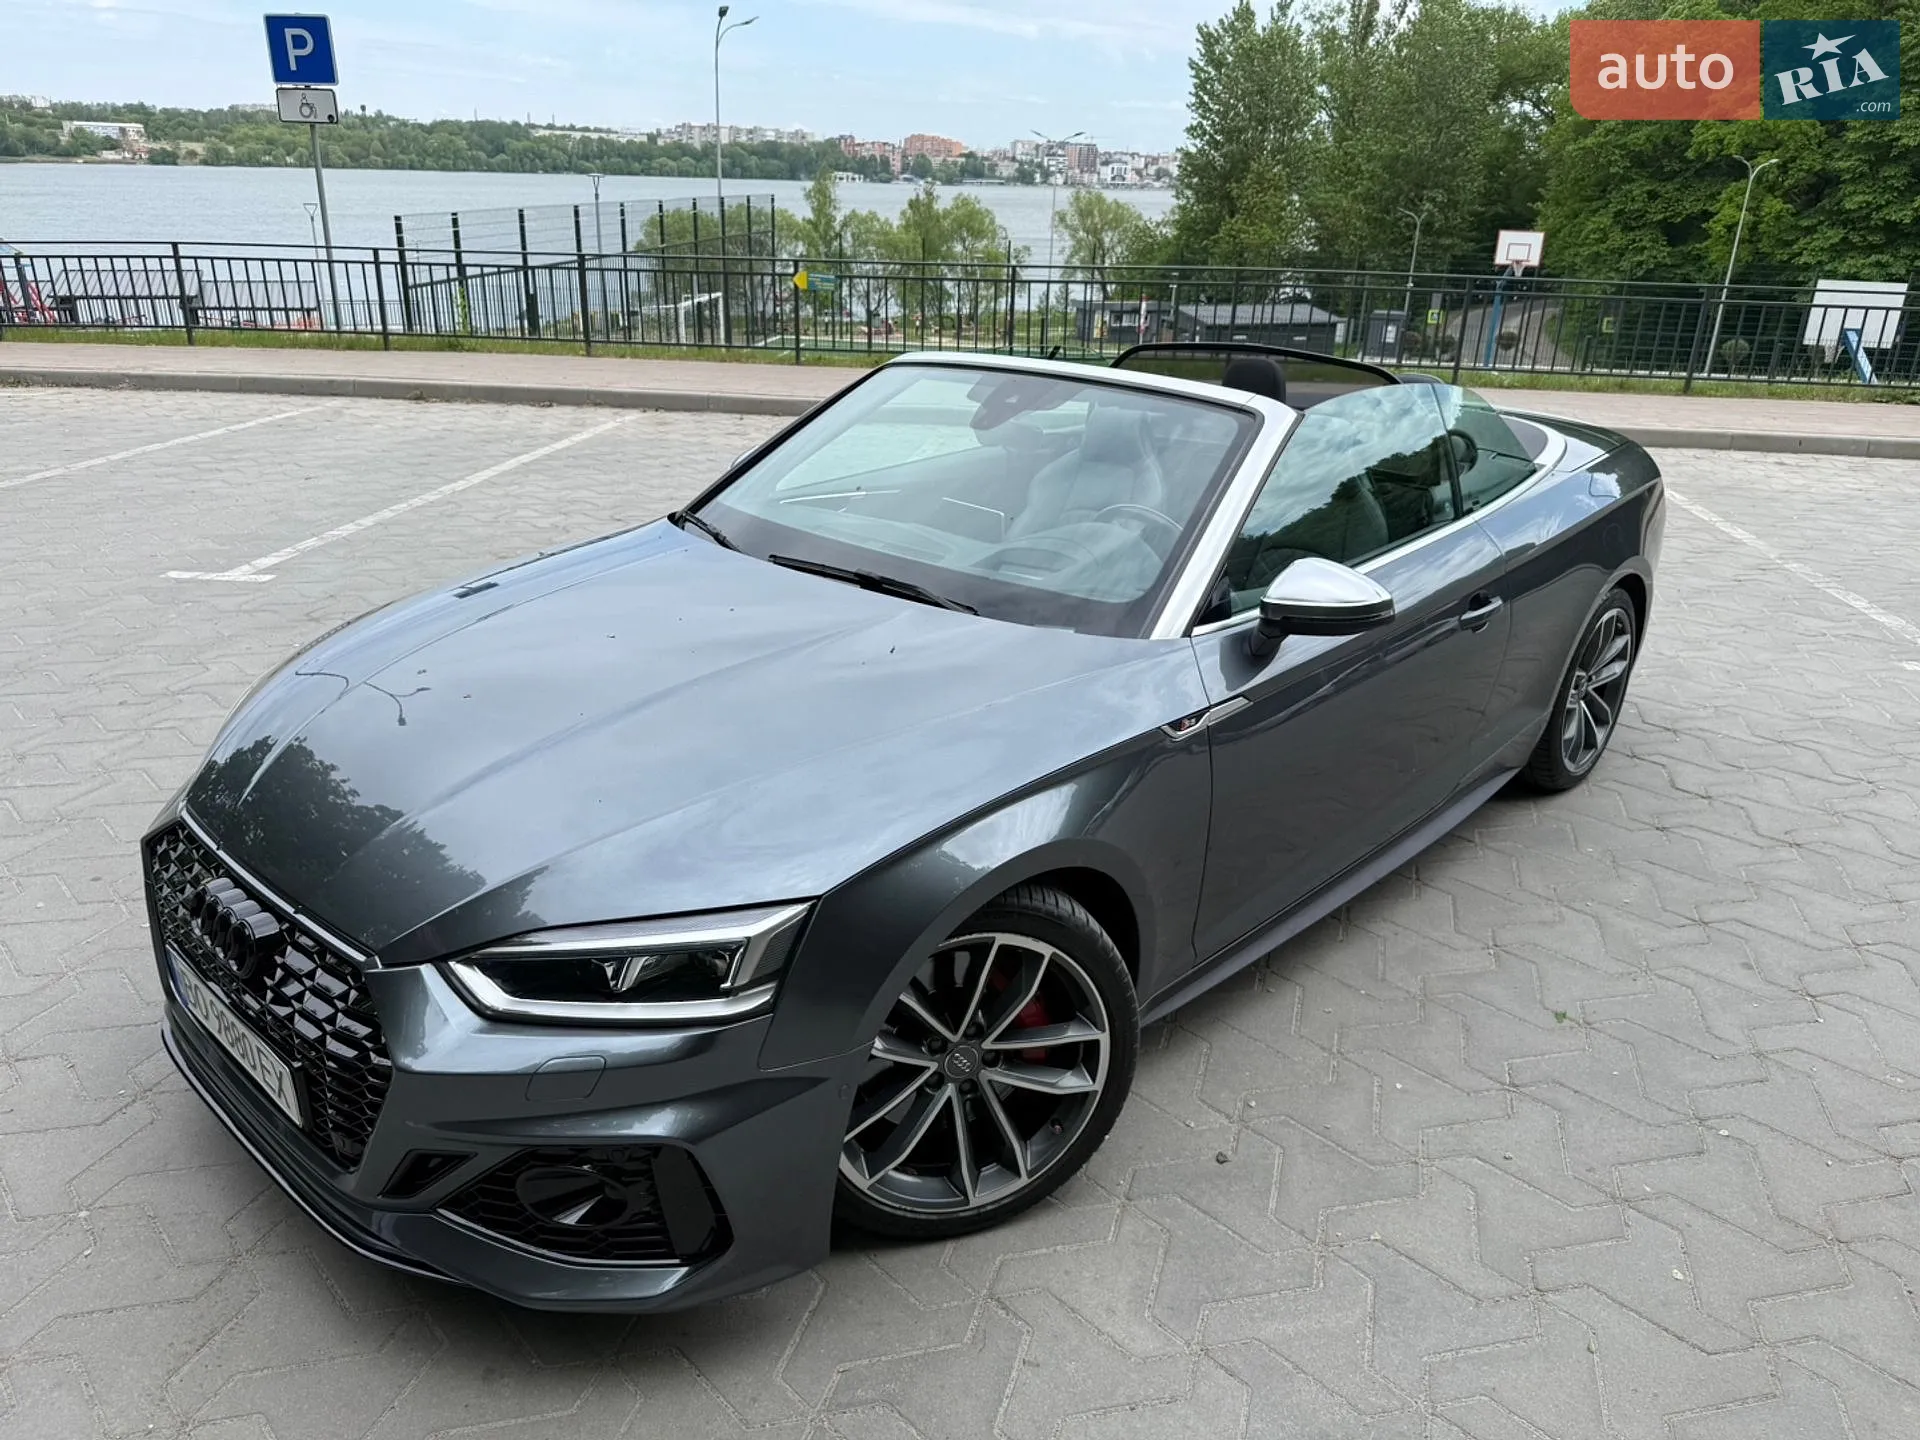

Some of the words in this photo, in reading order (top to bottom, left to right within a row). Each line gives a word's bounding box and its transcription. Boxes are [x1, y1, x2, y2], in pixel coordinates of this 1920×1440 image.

[284, 27, 314, 71] P
[209, 999, 257, 1071] 9880
[255, 1044, 291, 1110] EX
